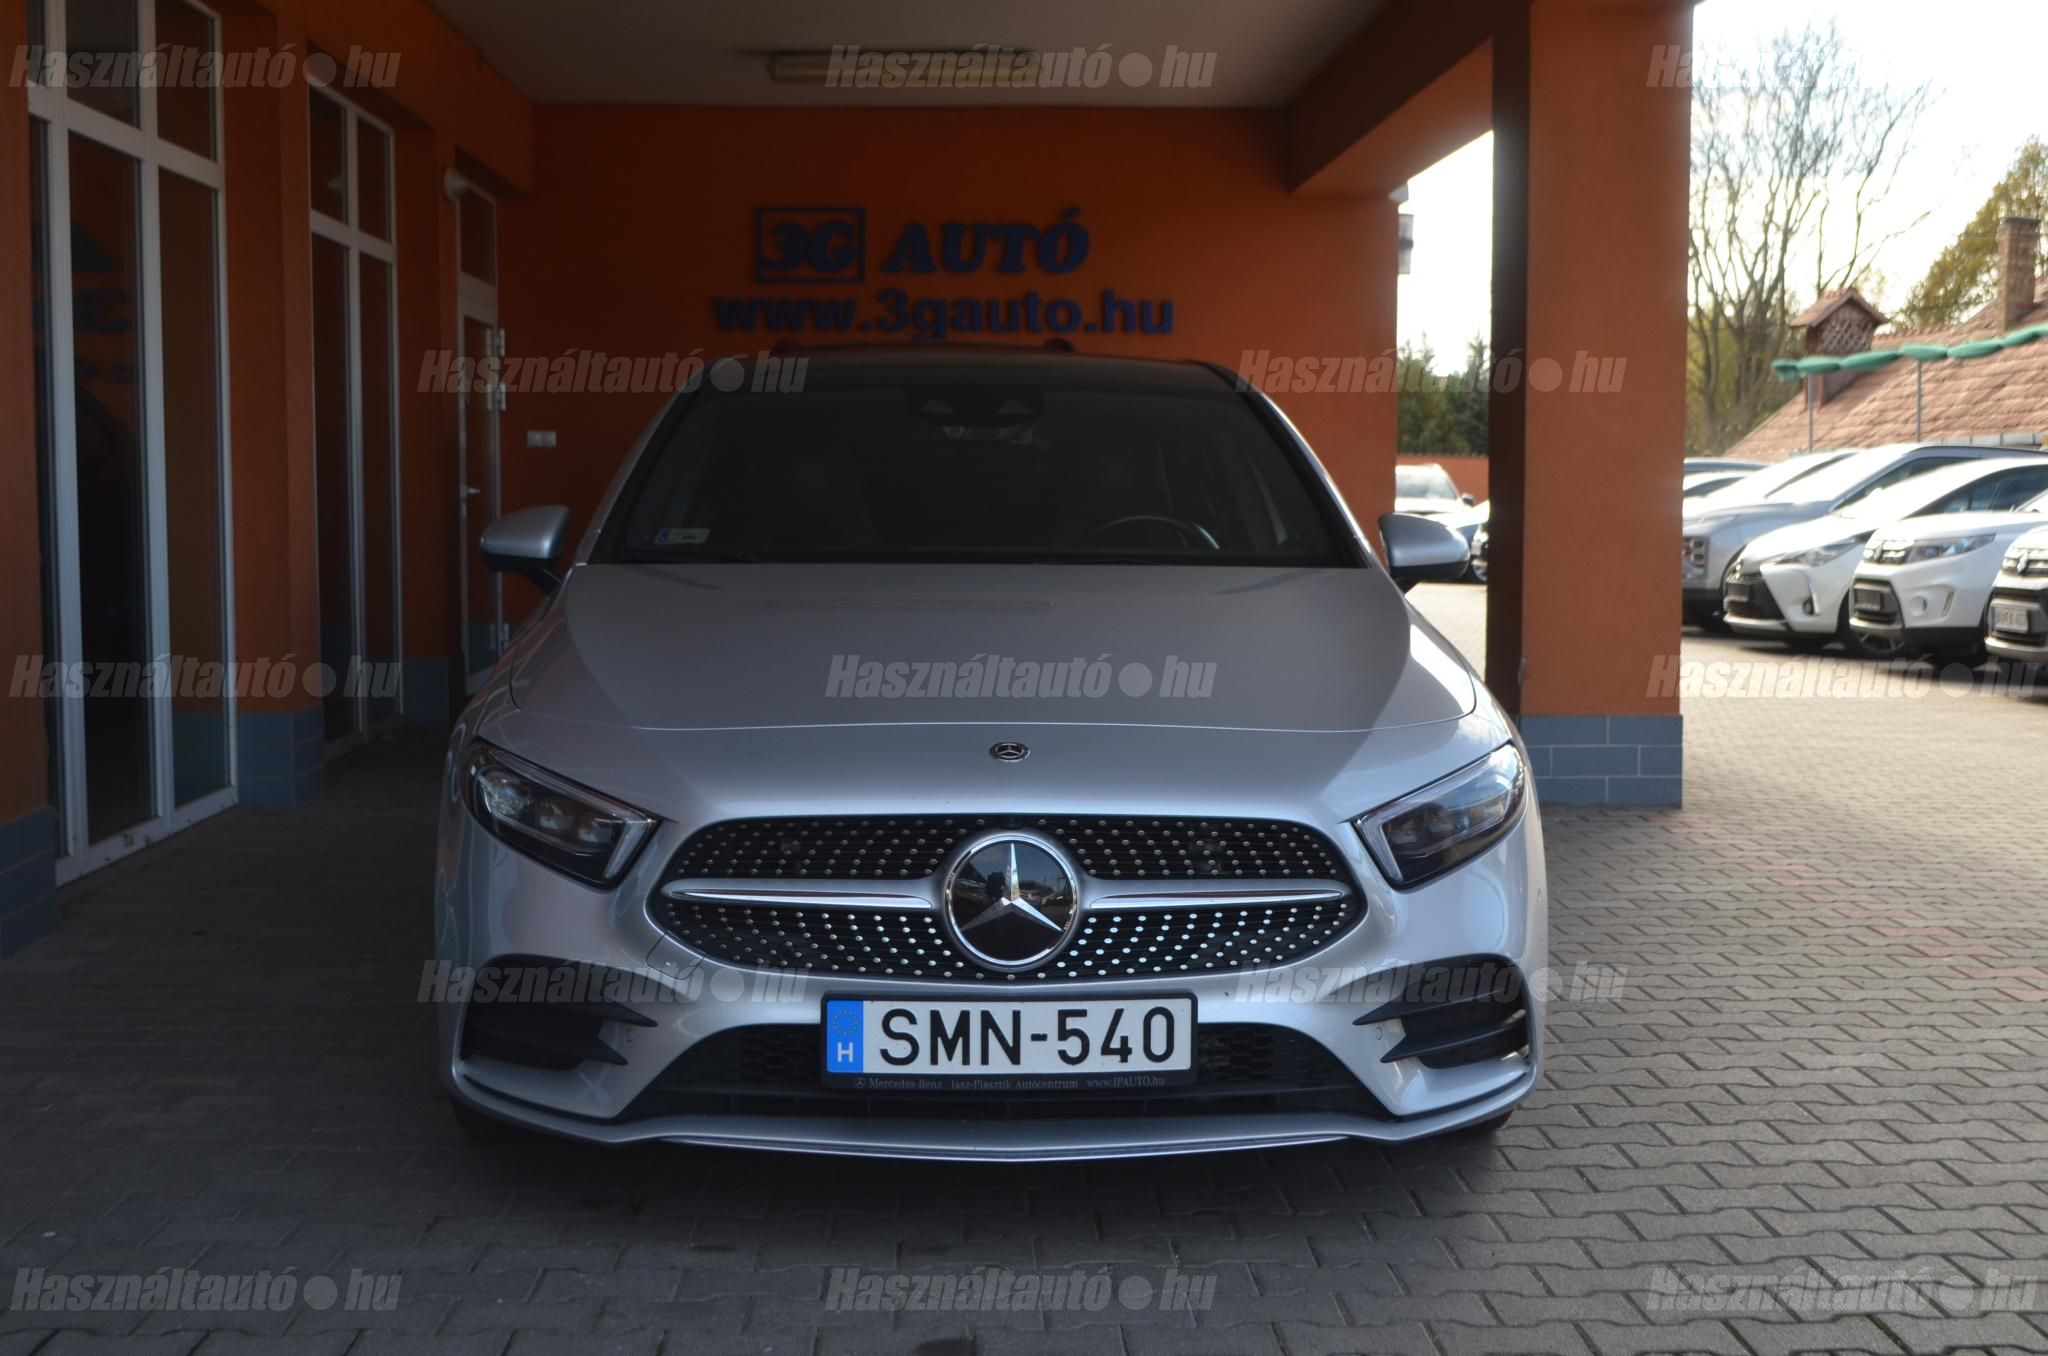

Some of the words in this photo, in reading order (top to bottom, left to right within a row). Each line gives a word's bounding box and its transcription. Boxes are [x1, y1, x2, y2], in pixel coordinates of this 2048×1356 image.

[760, 219, 859, 272] 3G
[879, 206, 1091, 274] AUTÓ
[711, 288, 1175, 340] www.3gauto.hu
[837, 1042, 853, 1063] H
[879, 1006, 1175, 1066] SMN-540
[869, 1078, 942, 1090] Mercedes-Benz
